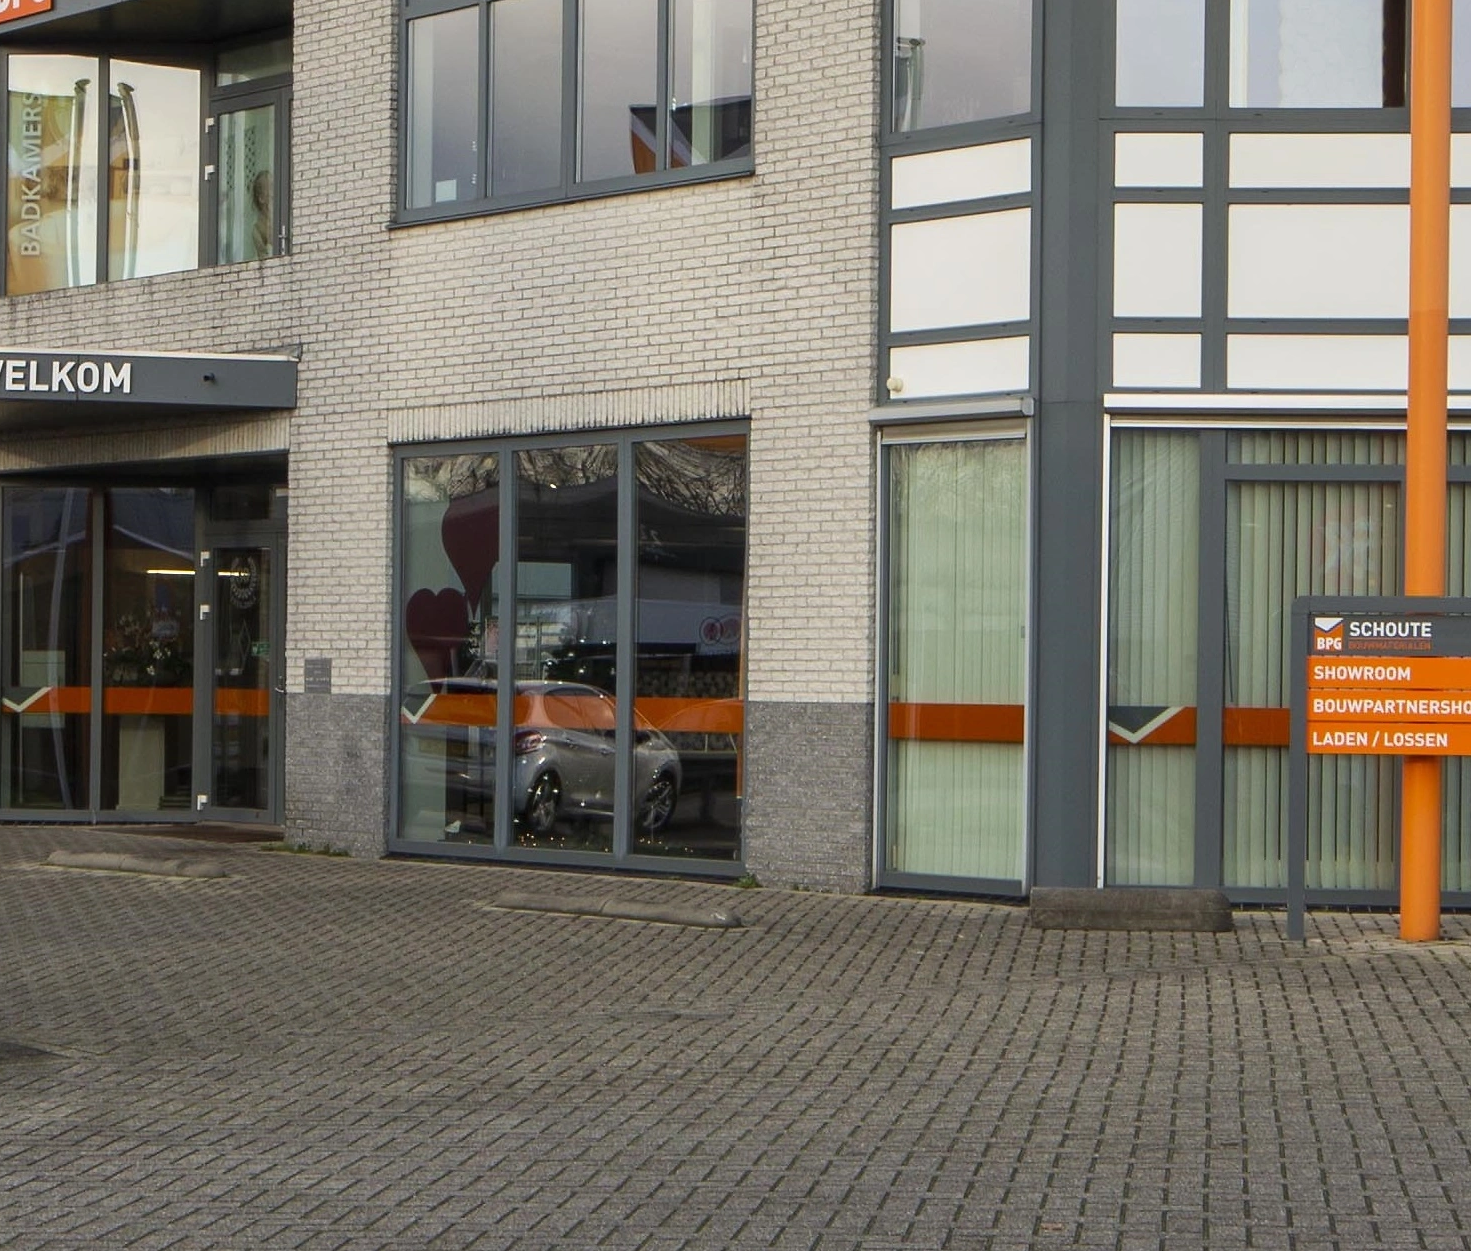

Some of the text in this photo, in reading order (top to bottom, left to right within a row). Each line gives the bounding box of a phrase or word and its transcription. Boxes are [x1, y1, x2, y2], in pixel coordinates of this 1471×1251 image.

[20, 93, 43, 256] BADKAMERS
[1349, 621, 1432, 637] SCHOUTE
[1316, 637, 1342, 650] BPG
[1313, 666, 1411, 681] SHOWROOM
[1312, 731, 1448, 747] LADEN / LOSSEN
